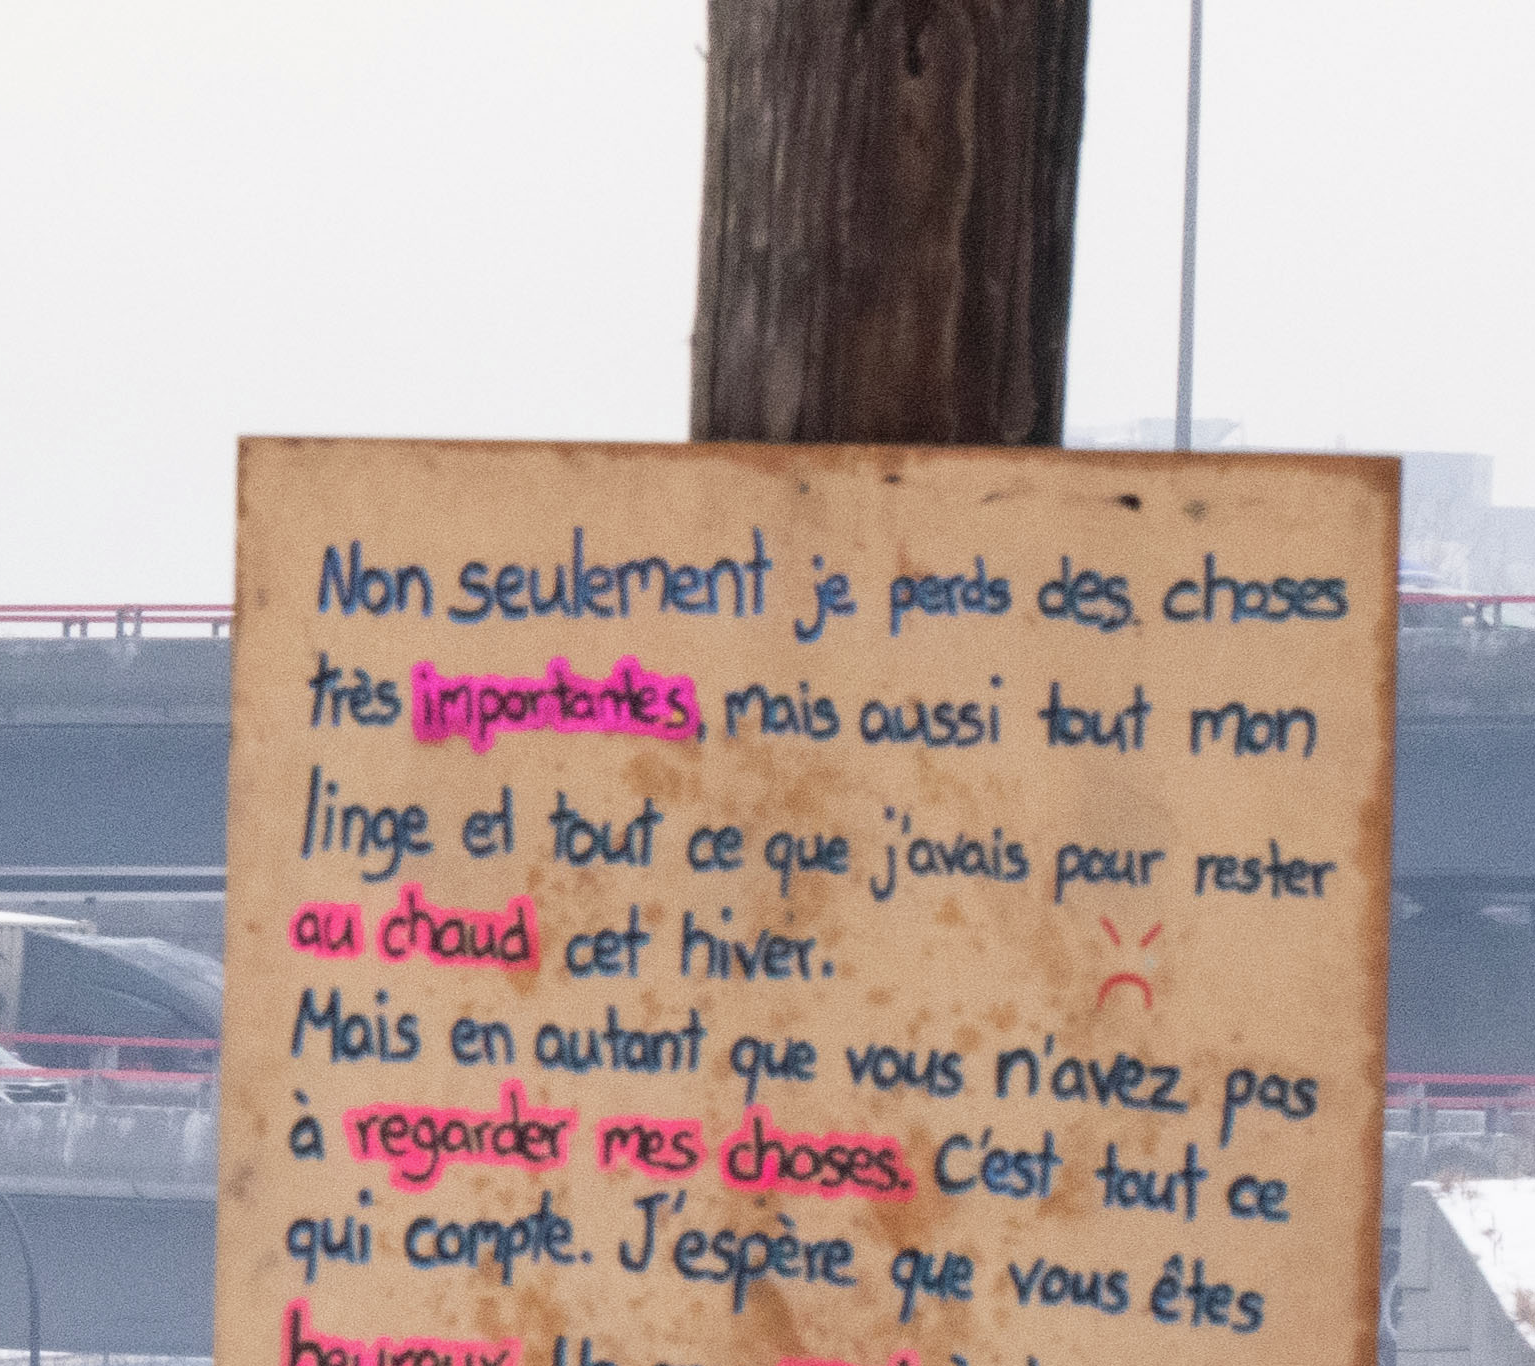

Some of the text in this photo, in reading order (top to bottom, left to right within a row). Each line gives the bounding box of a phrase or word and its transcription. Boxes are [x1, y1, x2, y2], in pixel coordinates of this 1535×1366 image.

[319, 543, 432, 614] Non
[450, 527, 771, 623] seulement
[795, 556, 855, 642] je
[890, 556, 1011, 634] perds
[1163, 555, 1348, 622] choses
[310, 653, 401, 725] très
[725, 680, 839, 740] mais
[860, 678, 1000, 747] aussi
[1040, 682, 1150, 750] tout
[1191, 702, 1316, 754] mon
[303, 768, 1333, 900] linge et tout ce que j'avais pour rester
[295, 890, 835, 979] au chaud cet hiver.
[292, 988, 1317, 1145] Mais en autant que vous n'avez pas
[290, 1090, 1288, 1221] à regarder mes choses. C'est tout ce
[287, 1191, 1263, 1333] qui compte. J'espère que vous êtes
